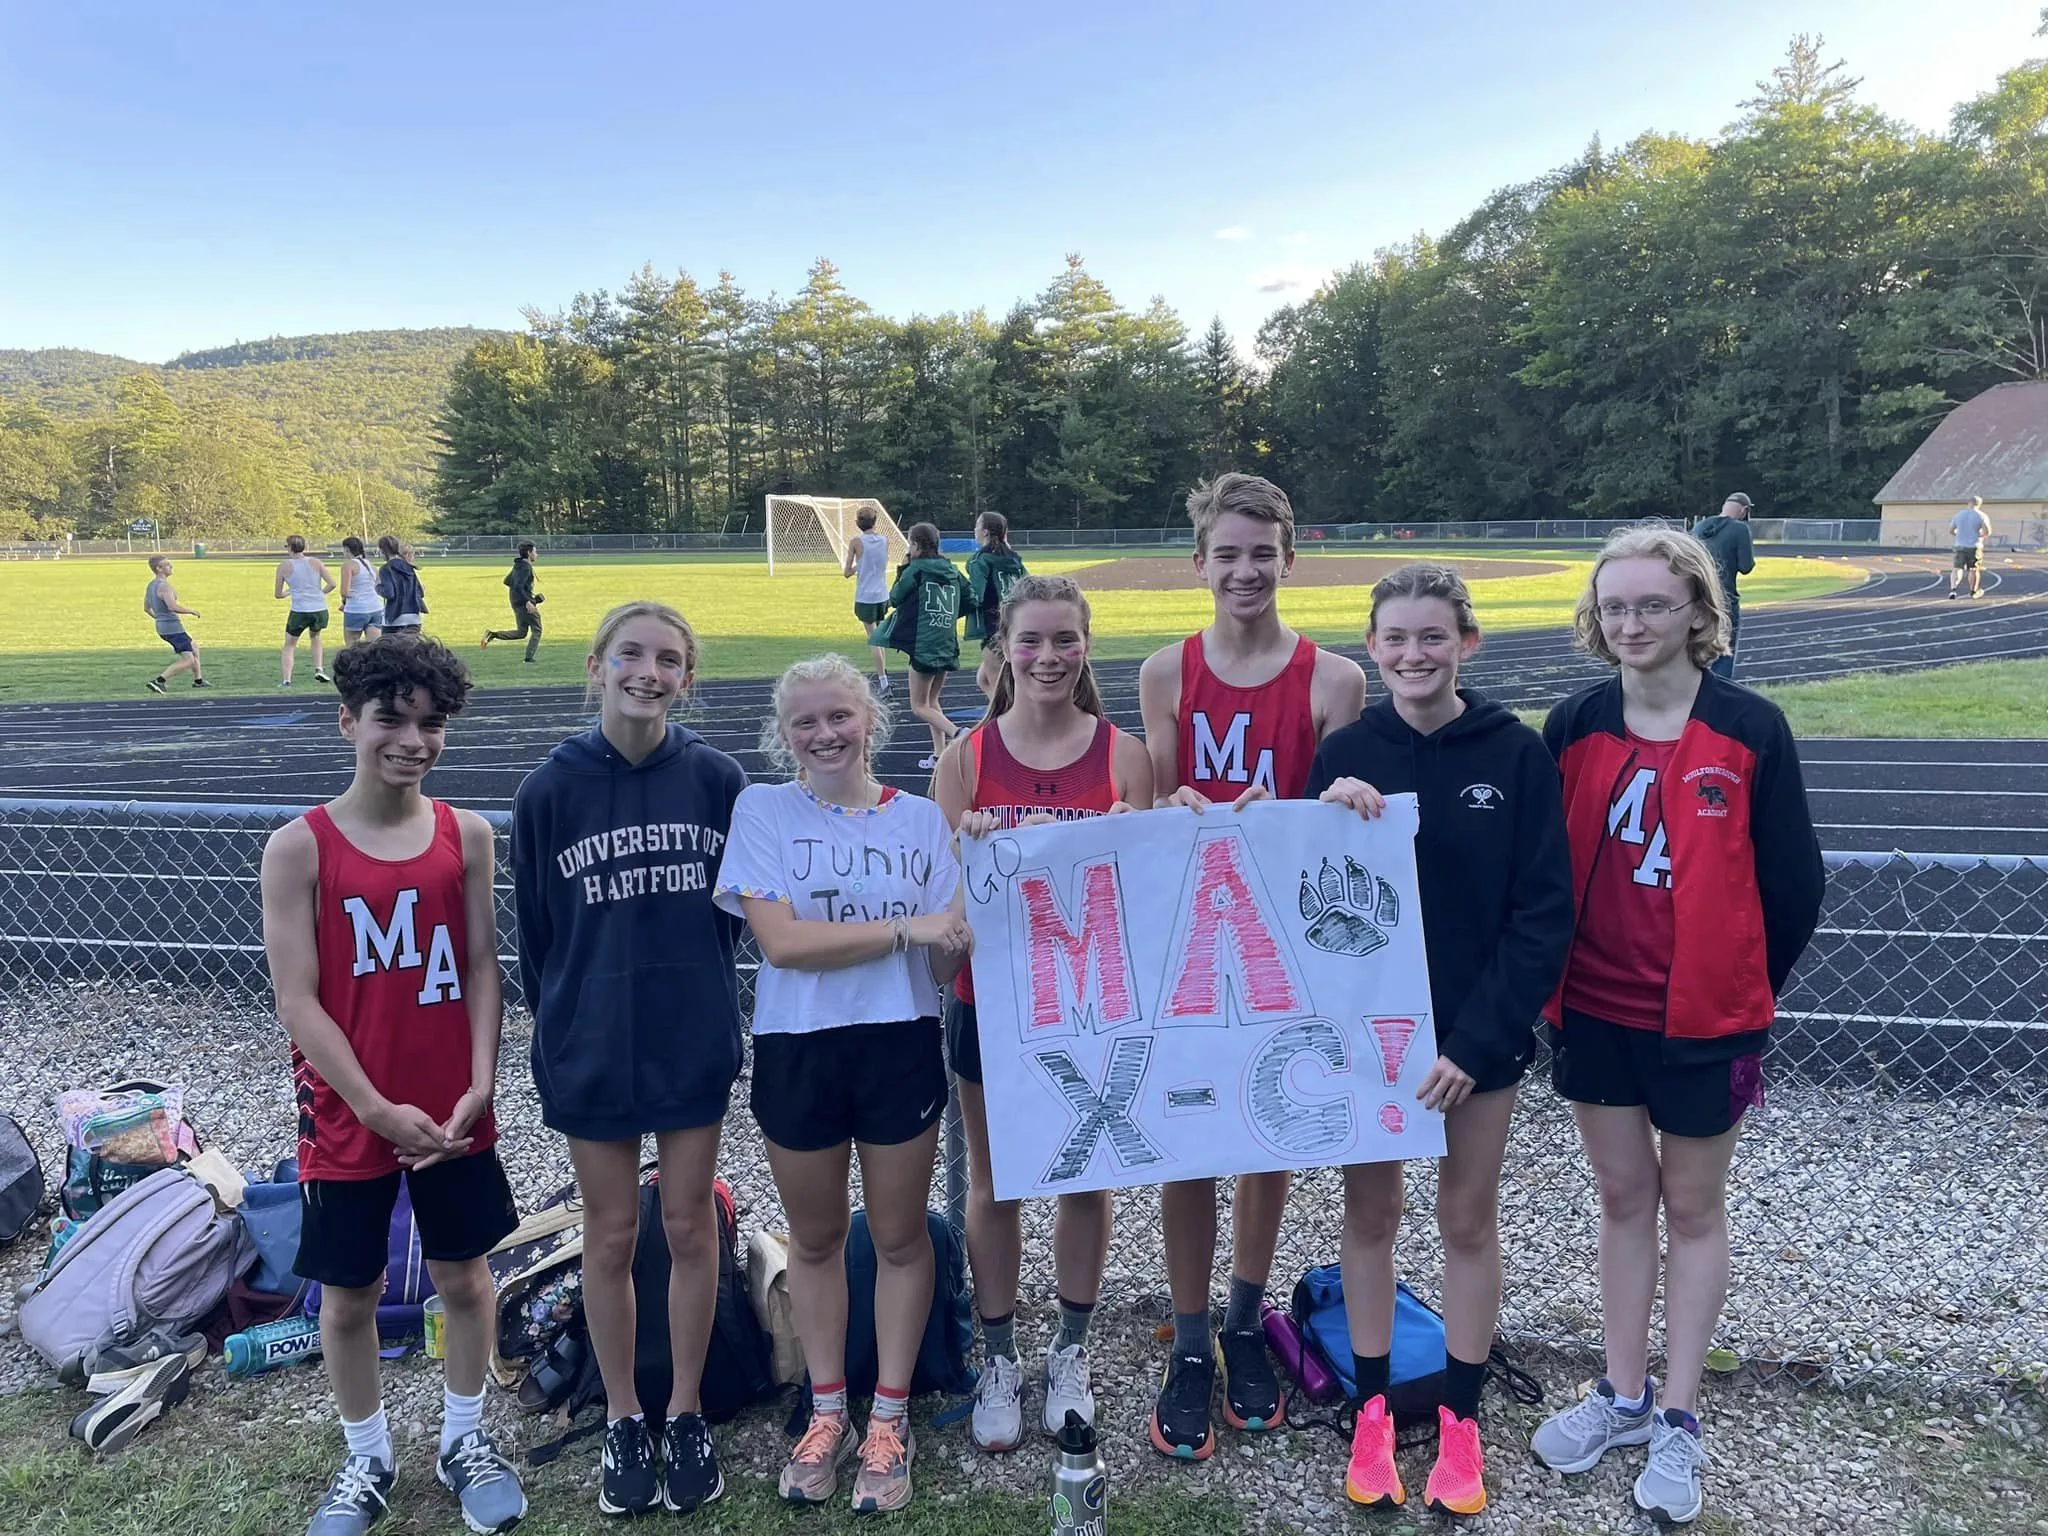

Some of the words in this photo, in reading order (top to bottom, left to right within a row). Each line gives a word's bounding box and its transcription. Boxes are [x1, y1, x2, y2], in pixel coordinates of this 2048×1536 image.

[925, 581, 955, 615] N
[930, 612, 952, 628] XC
[1192, 711, 1279, 800] MA
[557, 823, 700, 879] UNIVERSITY
[702, 827, 725, 856] OF
[966, 837, 1021, 905] GO
[583, 861, 707, 904] HARTFORD
[342, 887, 462, 1006] MA
[1007, 824, 1317, 1044] MA
